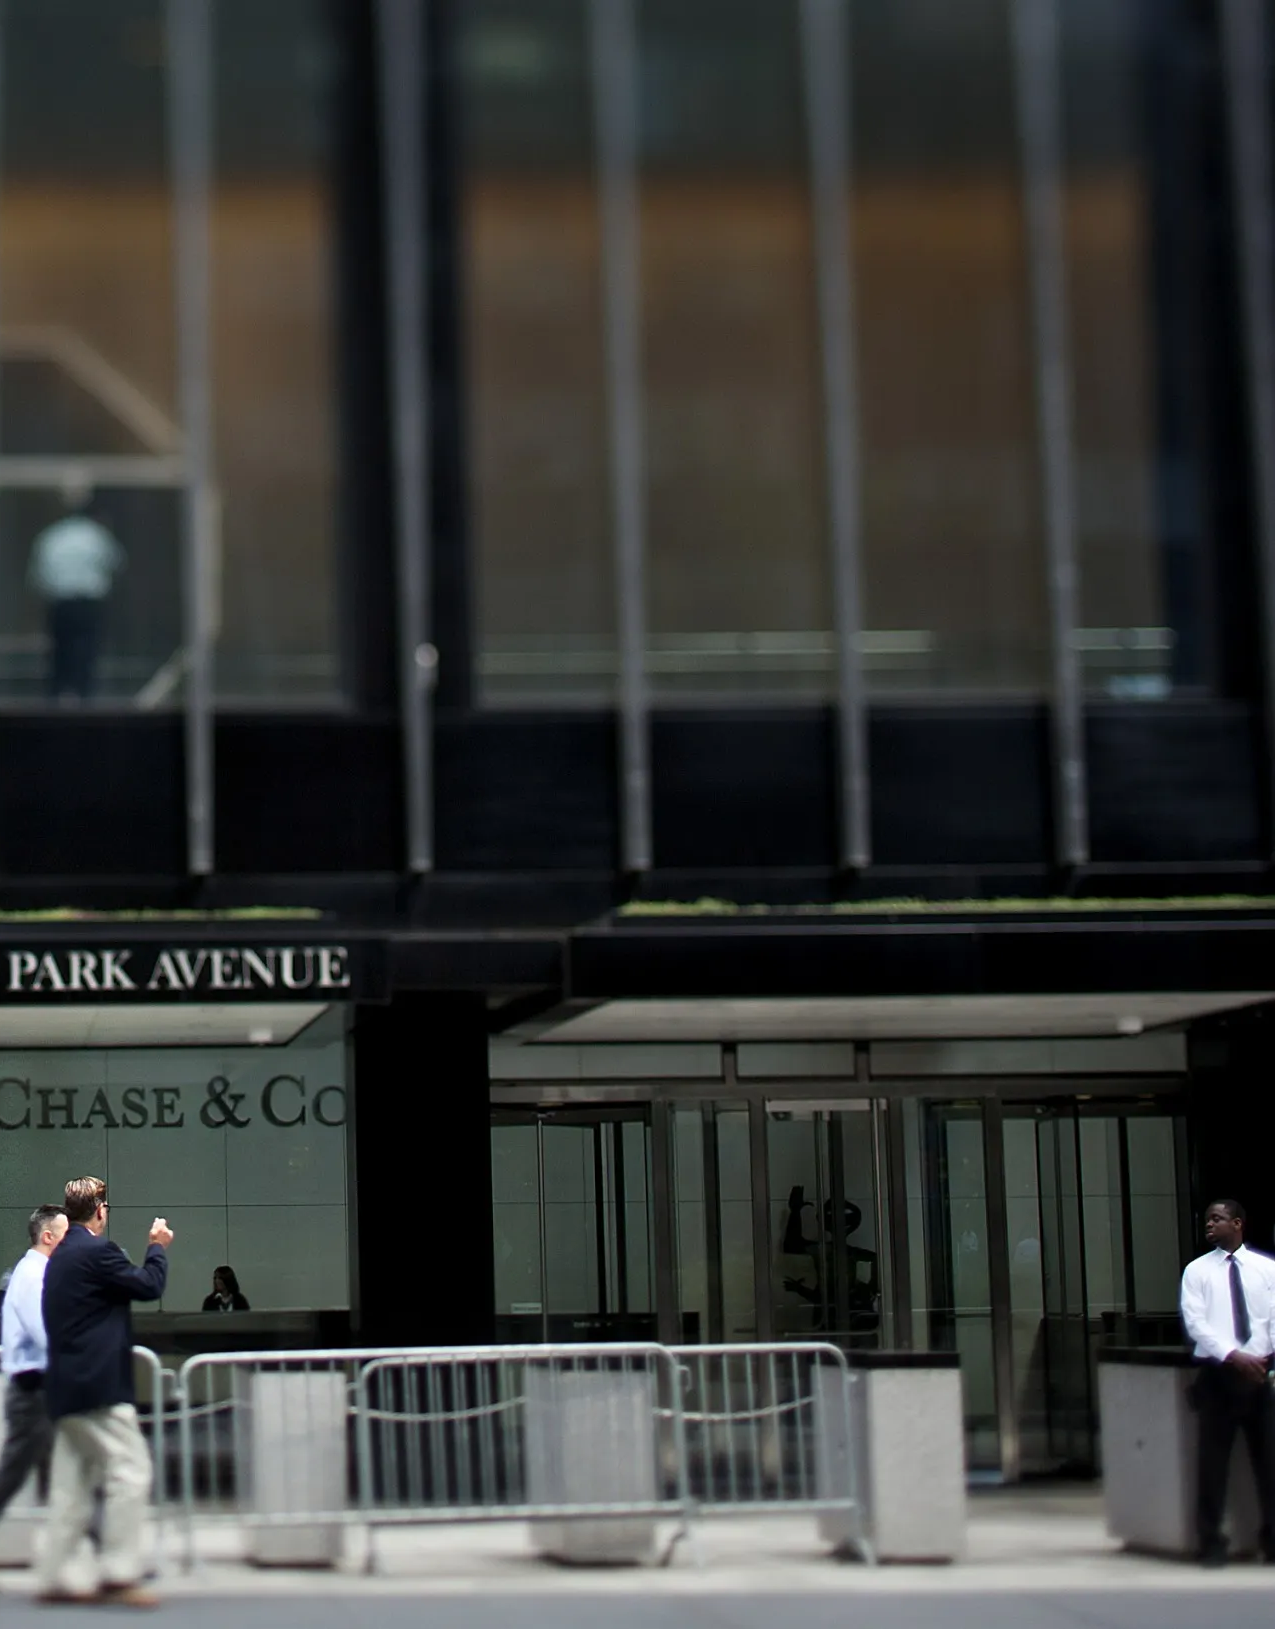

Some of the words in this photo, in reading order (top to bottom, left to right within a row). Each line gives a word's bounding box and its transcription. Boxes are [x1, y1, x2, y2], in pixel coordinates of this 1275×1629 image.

[8, 950, 137, 991] PARK
[146, 947, 350, 989] AVENUE
[199, 1075, 251, 1129] &
